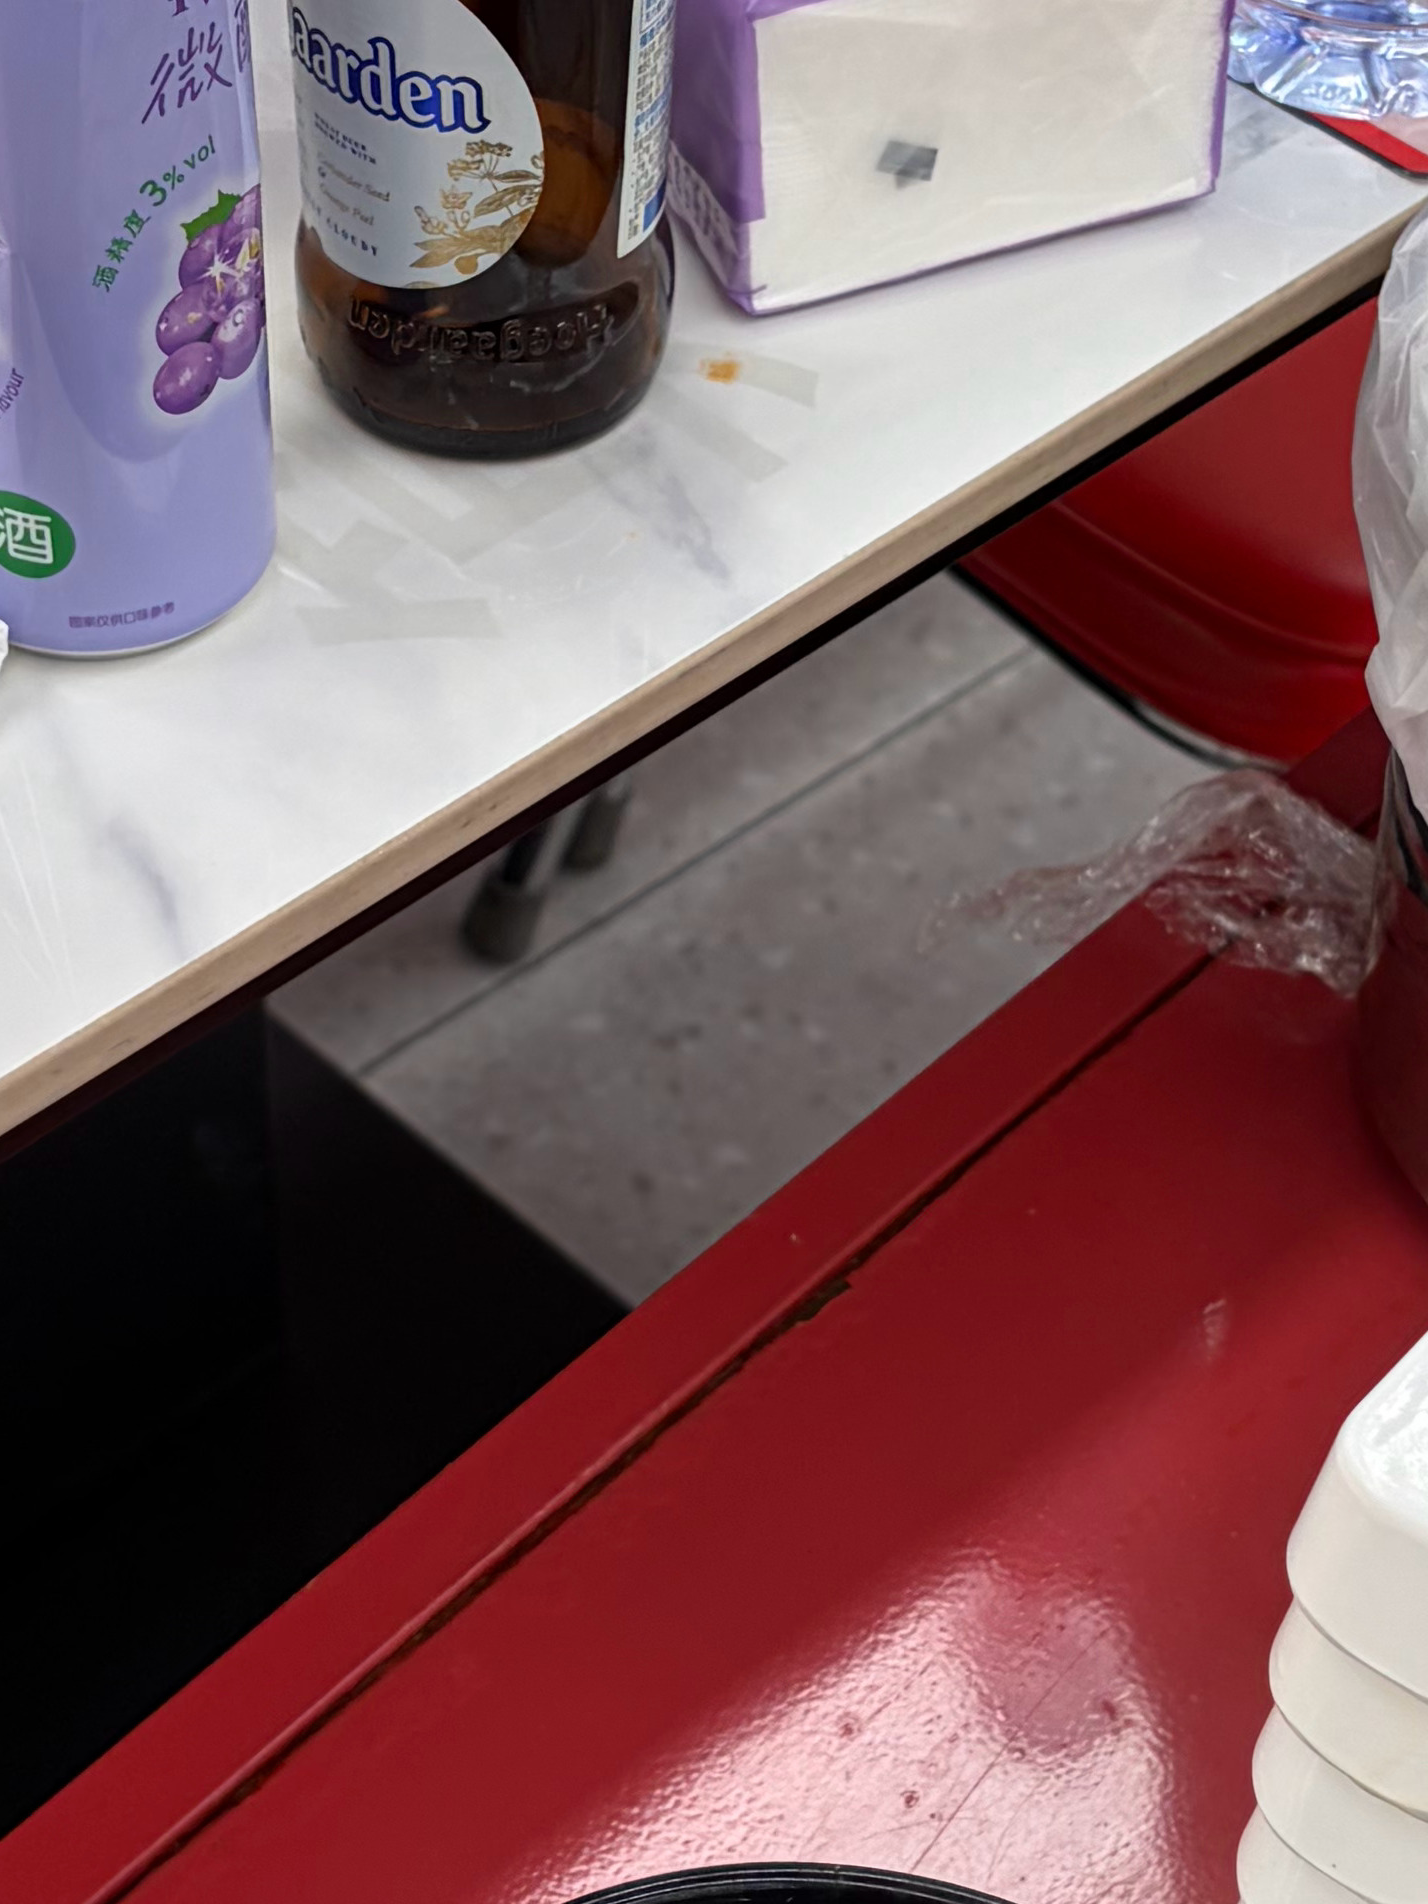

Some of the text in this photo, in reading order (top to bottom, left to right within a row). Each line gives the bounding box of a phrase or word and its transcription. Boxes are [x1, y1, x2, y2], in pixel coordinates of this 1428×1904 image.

[91, 134, 216, 293] 酒精度 3% vol
